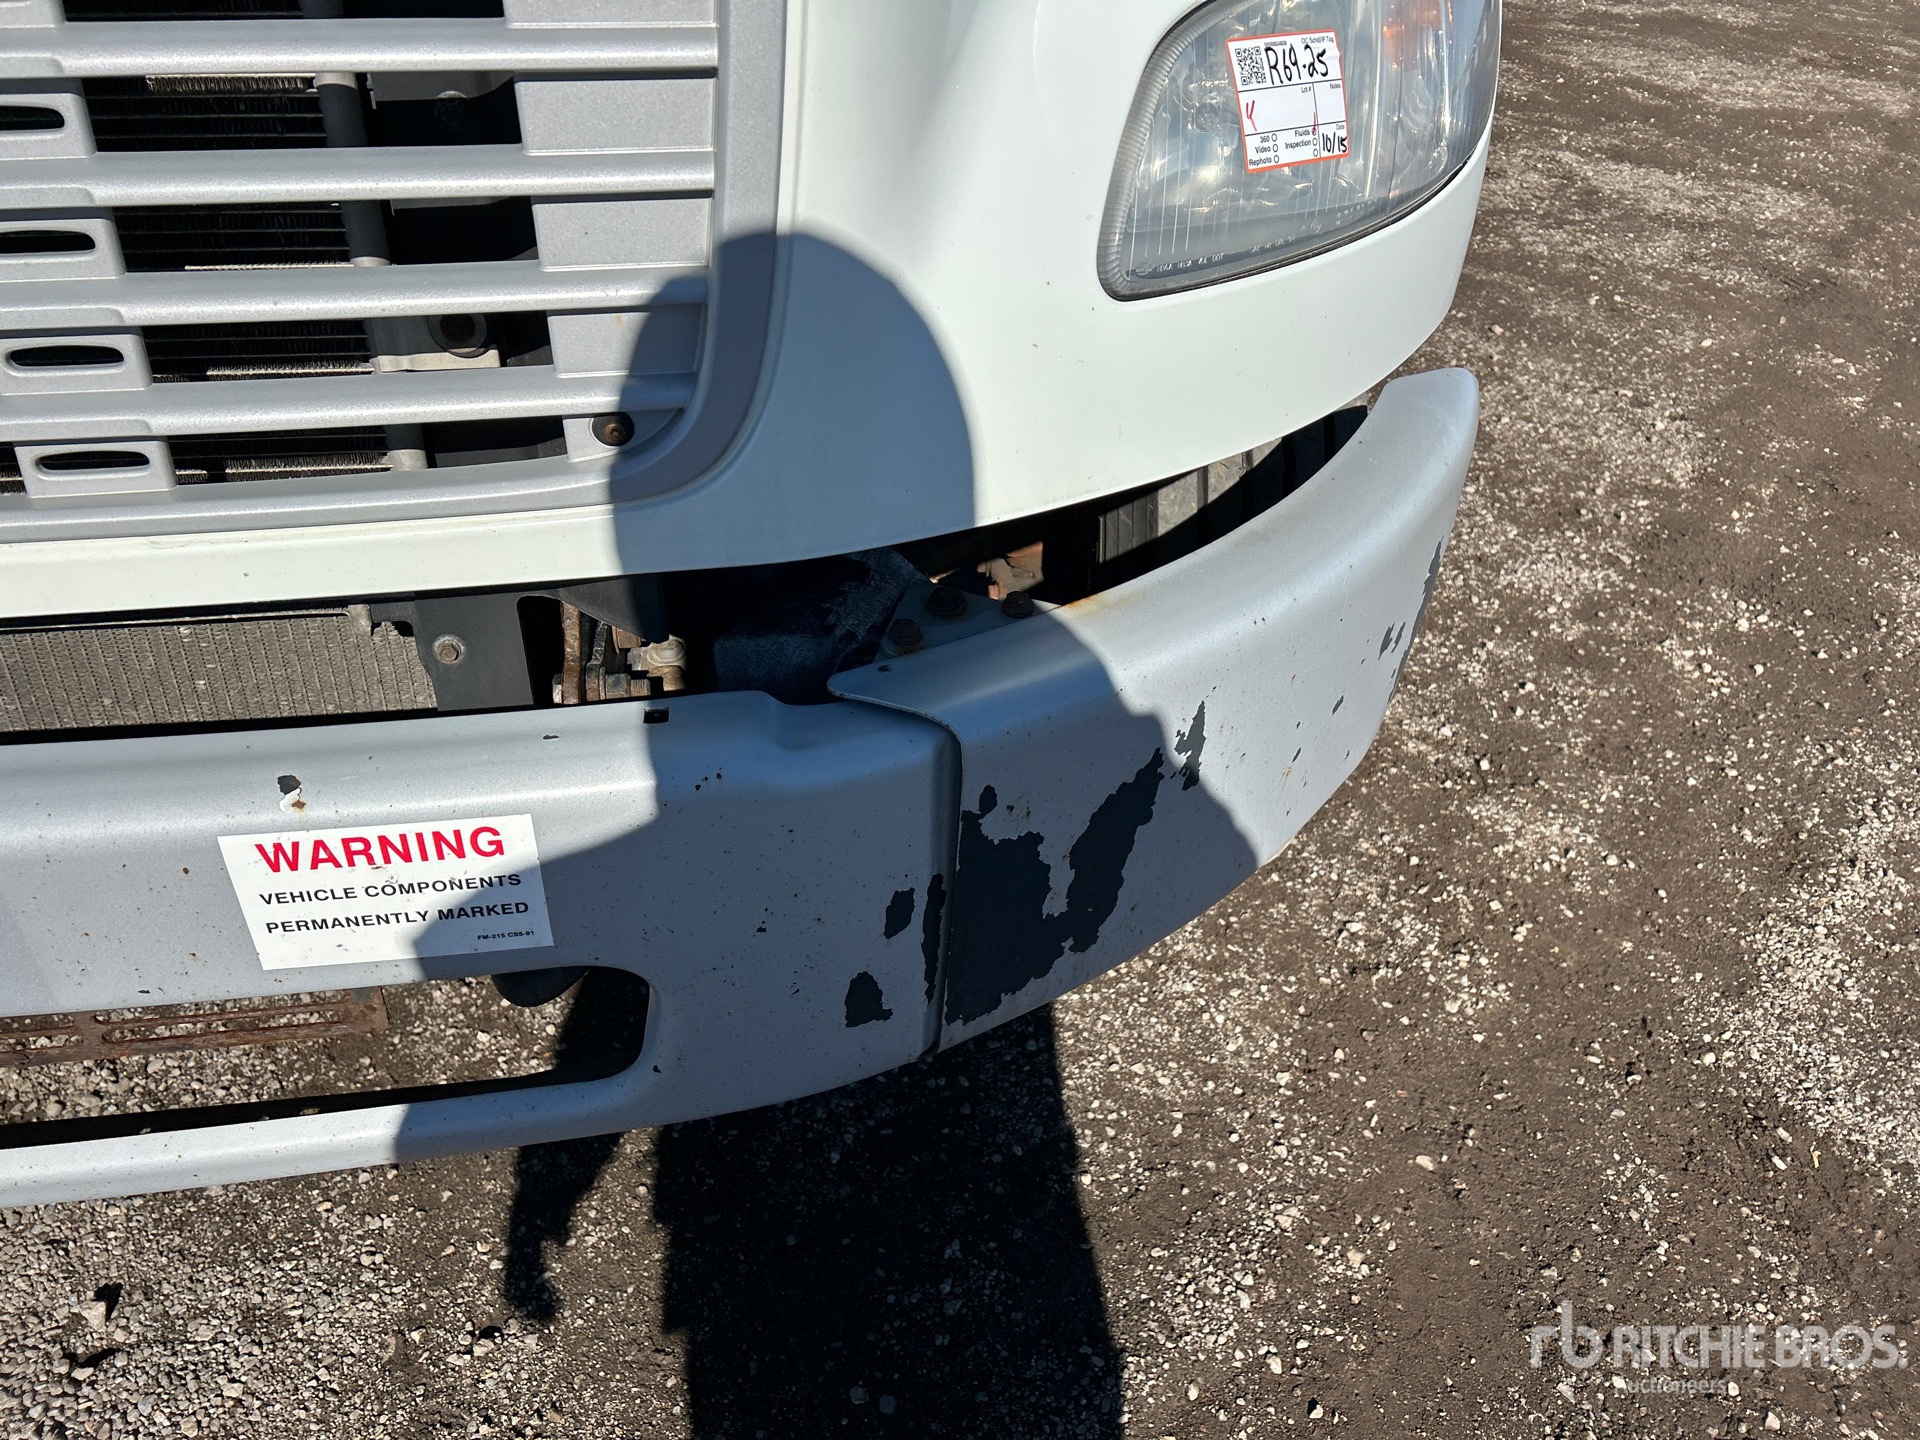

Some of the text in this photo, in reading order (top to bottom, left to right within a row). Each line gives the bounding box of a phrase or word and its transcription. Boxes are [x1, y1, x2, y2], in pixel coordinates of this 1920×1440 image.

[1294, 129, 1310, 138] Fluids
[1255, 146, 1271, 154] Video
[1285, 138, 1312, 149] Inspection
[1322, 132, 1348, 154] 10/15
[1248, 158, 1272, 167] Rephoto
[255, 826, 505, 873] WARNING
[259, 873, 522, 905] VEHICLE COMPONENTS
[265, 901, 529, 934] PERMANENTLY MARKED
